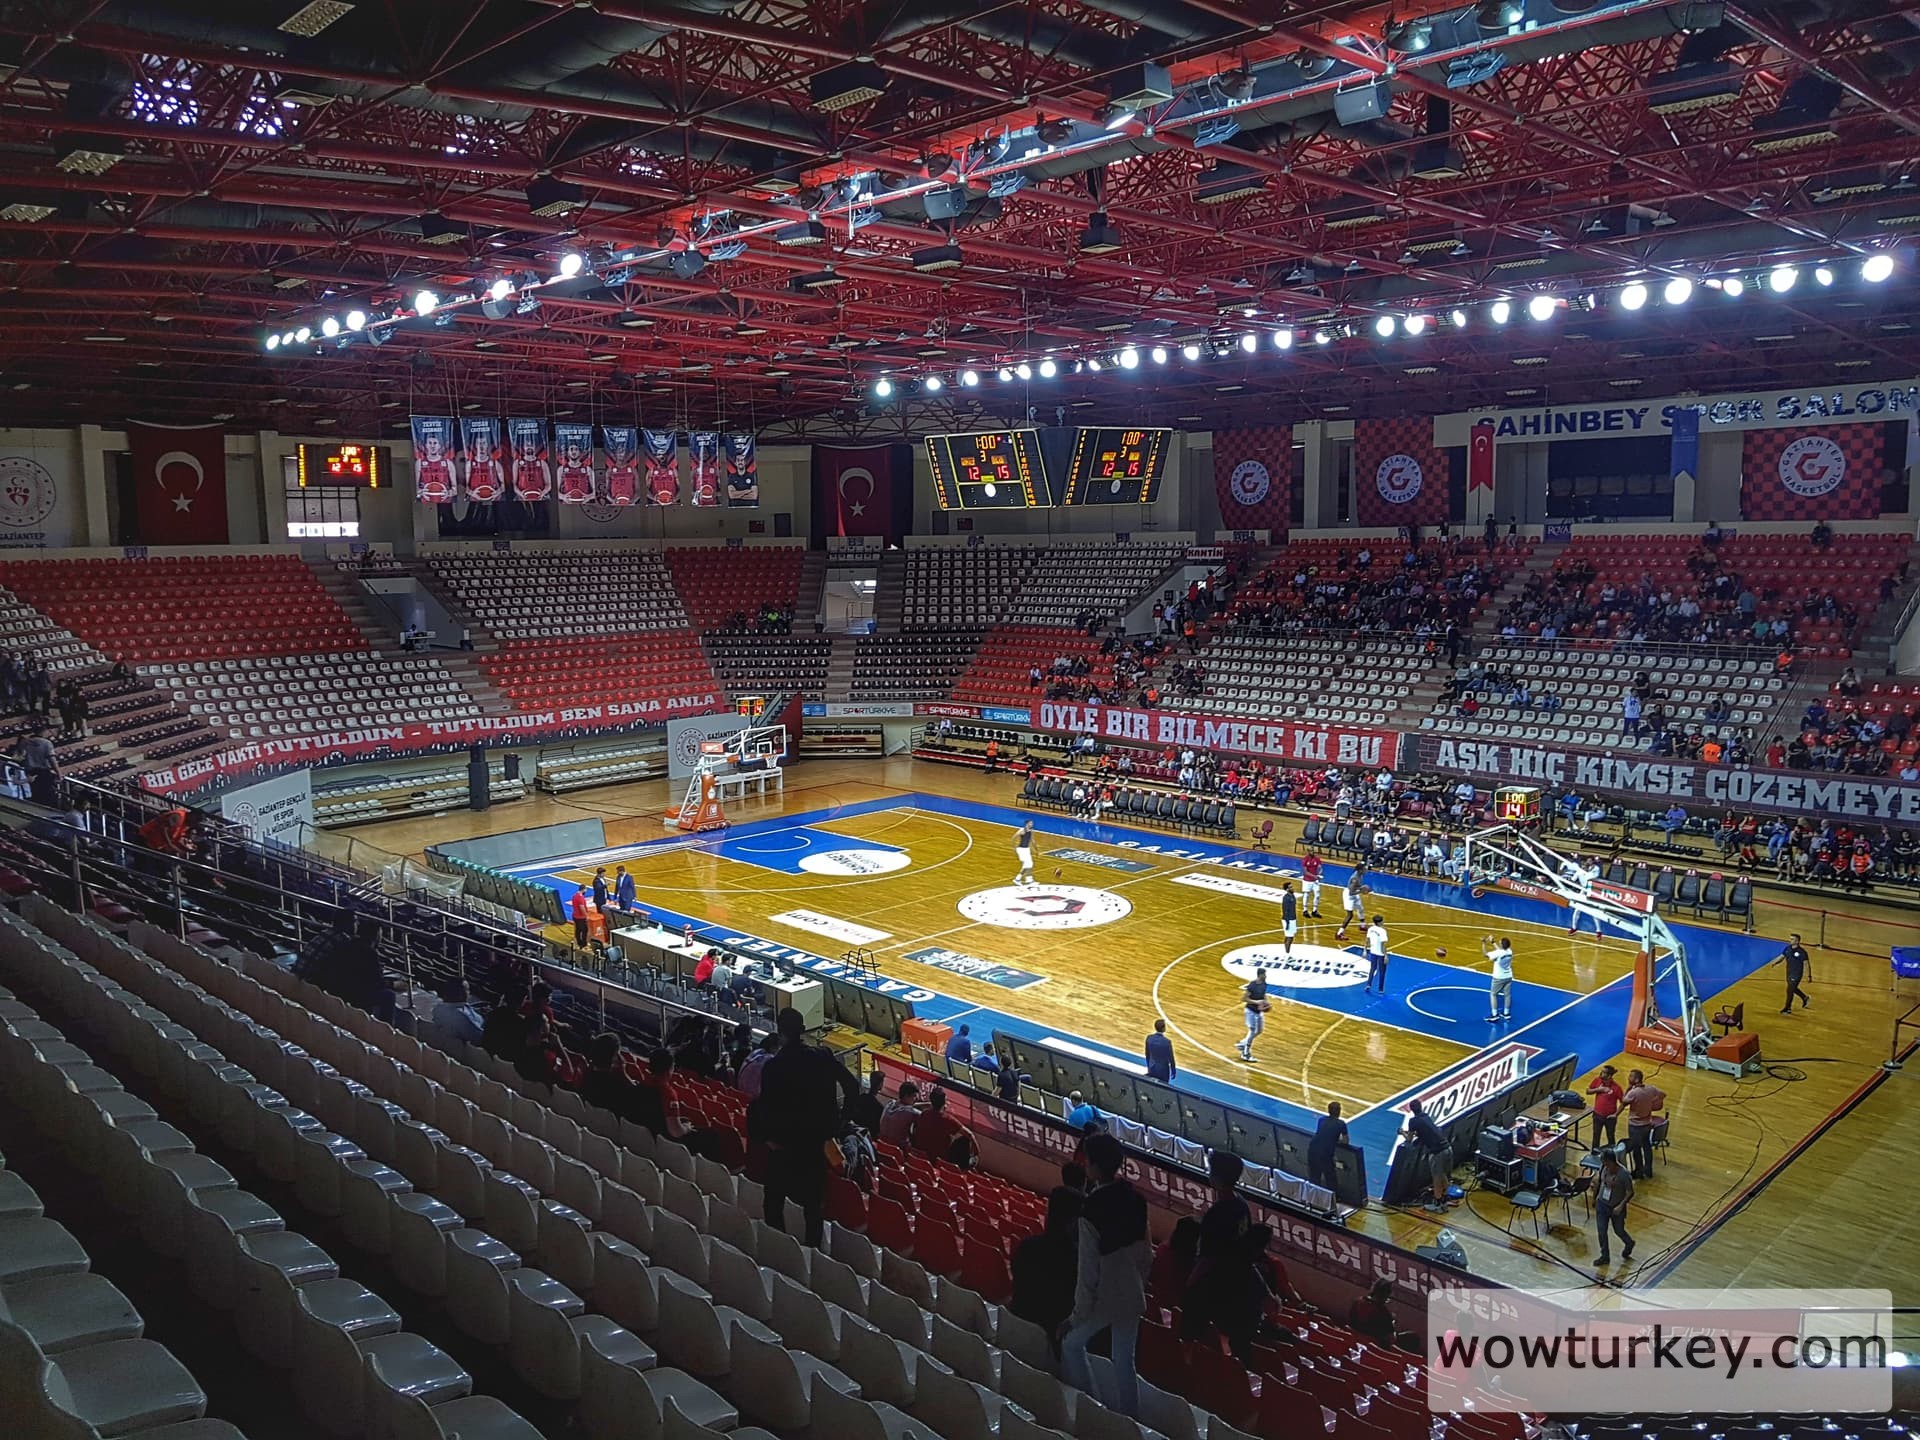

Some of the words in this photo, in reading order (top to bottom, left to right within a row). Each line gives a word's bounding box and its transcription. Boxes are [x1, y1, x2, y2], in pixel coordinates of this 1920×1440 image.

[980, 450, 987, 462] 3
[1120, 446, 1127, 458] 3
[332, 463, 341, 472] 12
[353, 463, 362, 472] 15
[968, 466, 980, 480] 12
[997, 465, 1010, 479] 15
[1102, 462, 1115, 475] 12
[1128, 462, 1139, 475] 15
[178, 757, 214, 781] GECE
[264, 727, 404, 756] TUTULDUM
[427, 713, 555, 735] TUTULDUM
[560, 706, 602, 722] BEN
[608, 699, 661, 716] SANA
[667, 694, 716, 709] ANLA
[1338, 735, 1383, 767] BU
[1437, 740, 1499, 776] AŞK
[1510, 744, 1565, 787] HİÇ
[1575, 751, 1695, 796] KİMSE
[1506, 803, 1520, 816] 14
[1510, 883, 1527, 894] ING
[1637, 1038, 1663, 1053] ING
